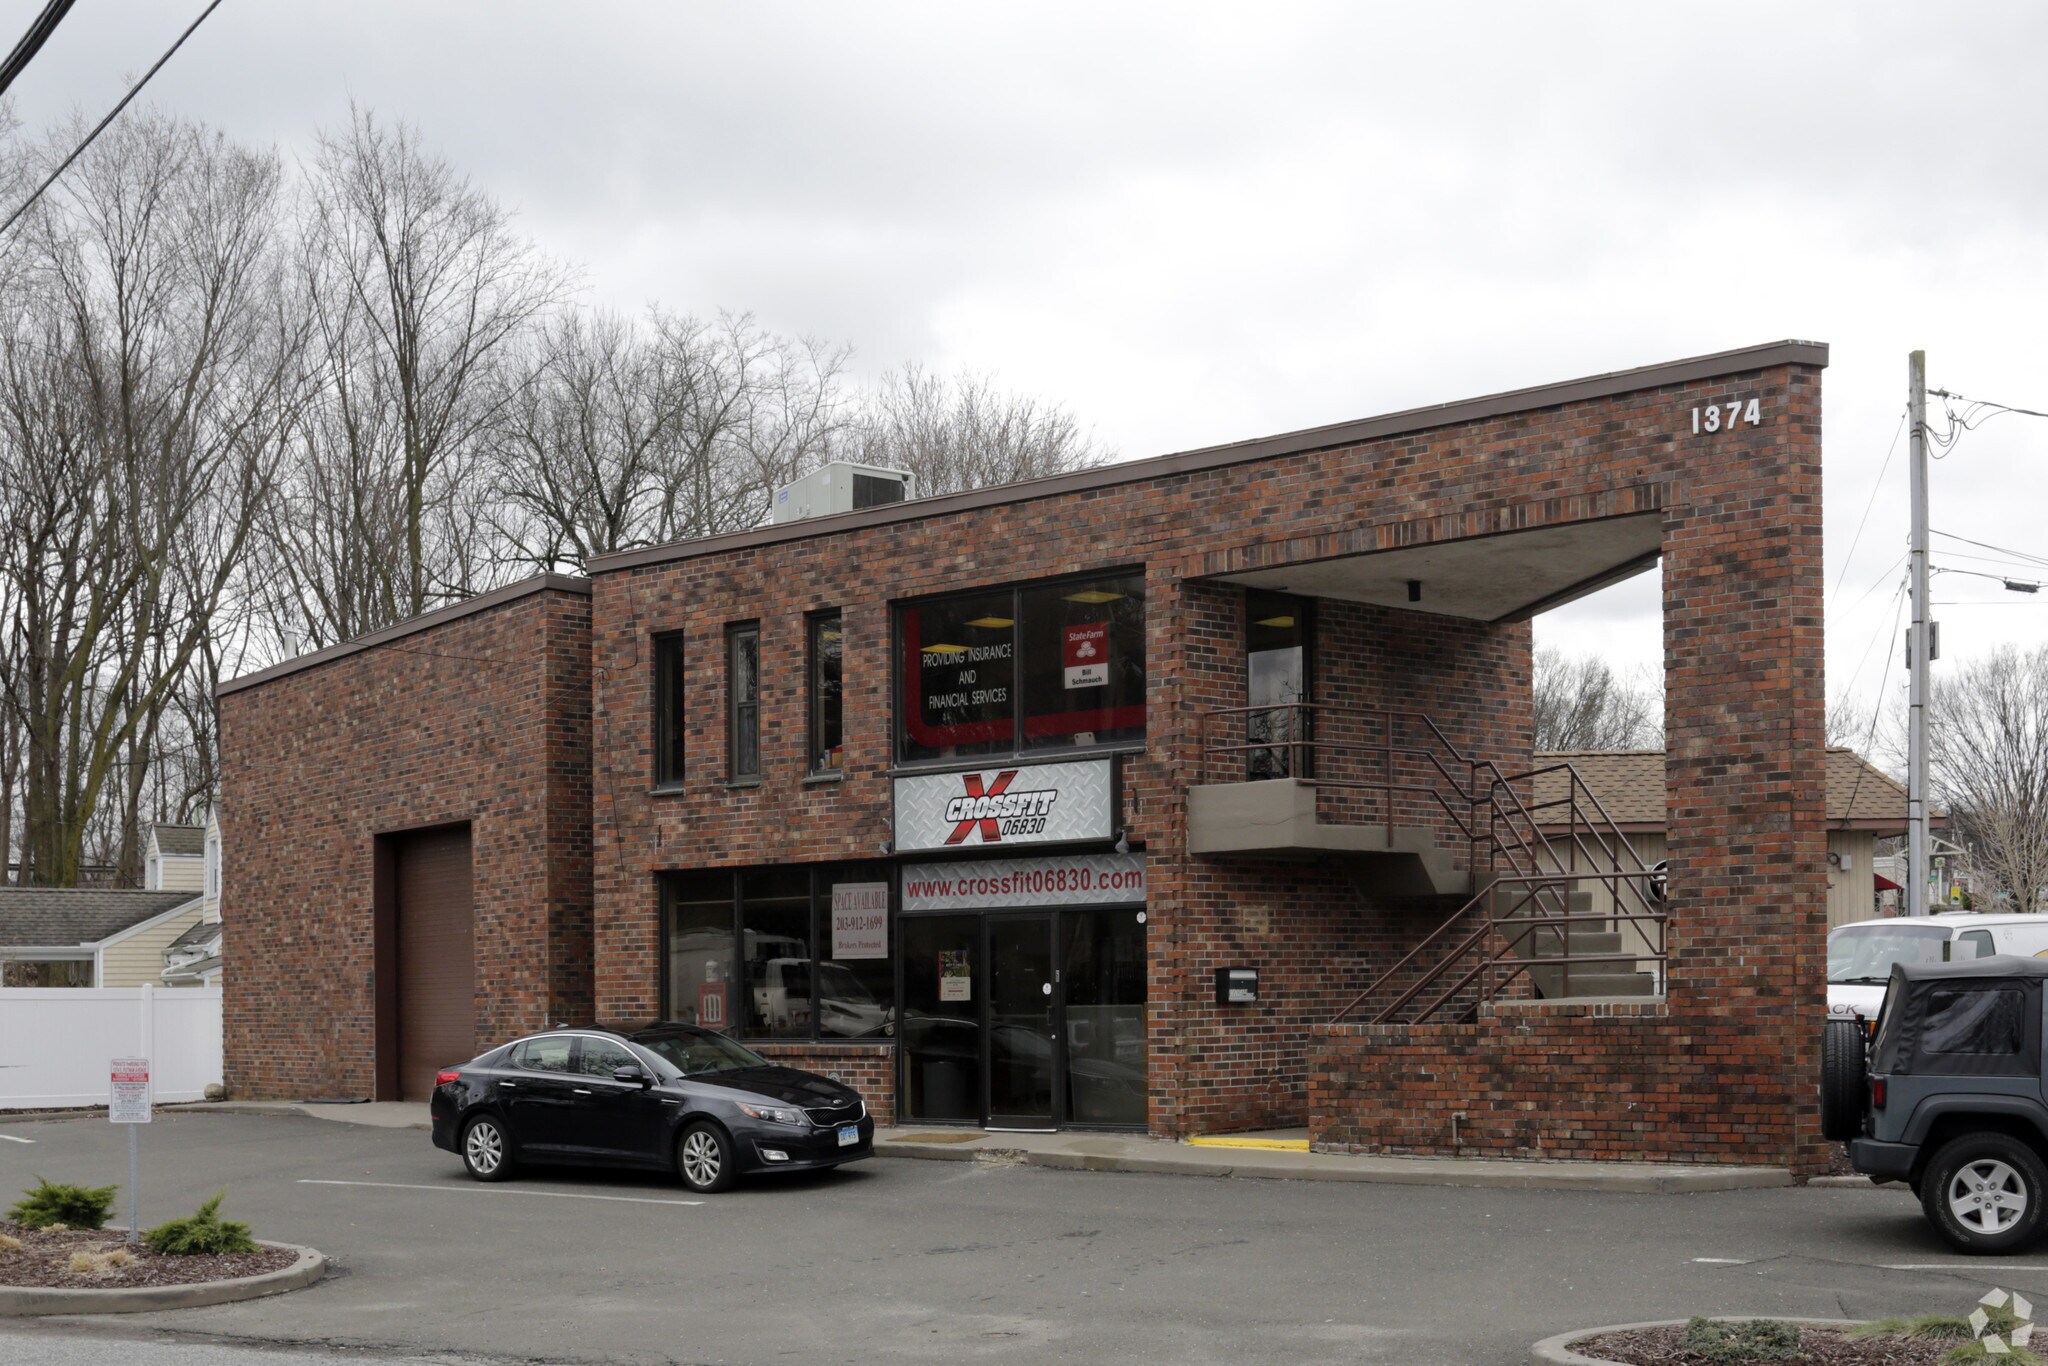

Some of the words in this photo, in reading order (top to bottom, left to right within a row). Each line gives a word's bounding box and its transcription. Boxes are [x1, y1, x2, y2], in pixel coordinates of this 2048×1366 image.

[1692, 398, 1761, 435] 1374
[923, 649, 965, 668] PROVIDING
[968, 643, 1012, 663] INSURANCE
[958, 670, 977, 684] AND
[1072, 676, 1103, 686] Schmauch
[1082, 668, 1092, 676] Bill
[929, 692, 969, 710] FINANCIAL
[971, 688, 1007, 705] SERVICES
[945, 789, 1058, 822] CROSSFIT
[1001, 817, 1046, 836] 06830
[907, 867, 1143, 898] www.crossfit06830.com
[834, 892, 851, 911] SPACE
[853, 891, 887, 911] AVAILABLE
[836, 915, 883, 931] 203-912-1699
